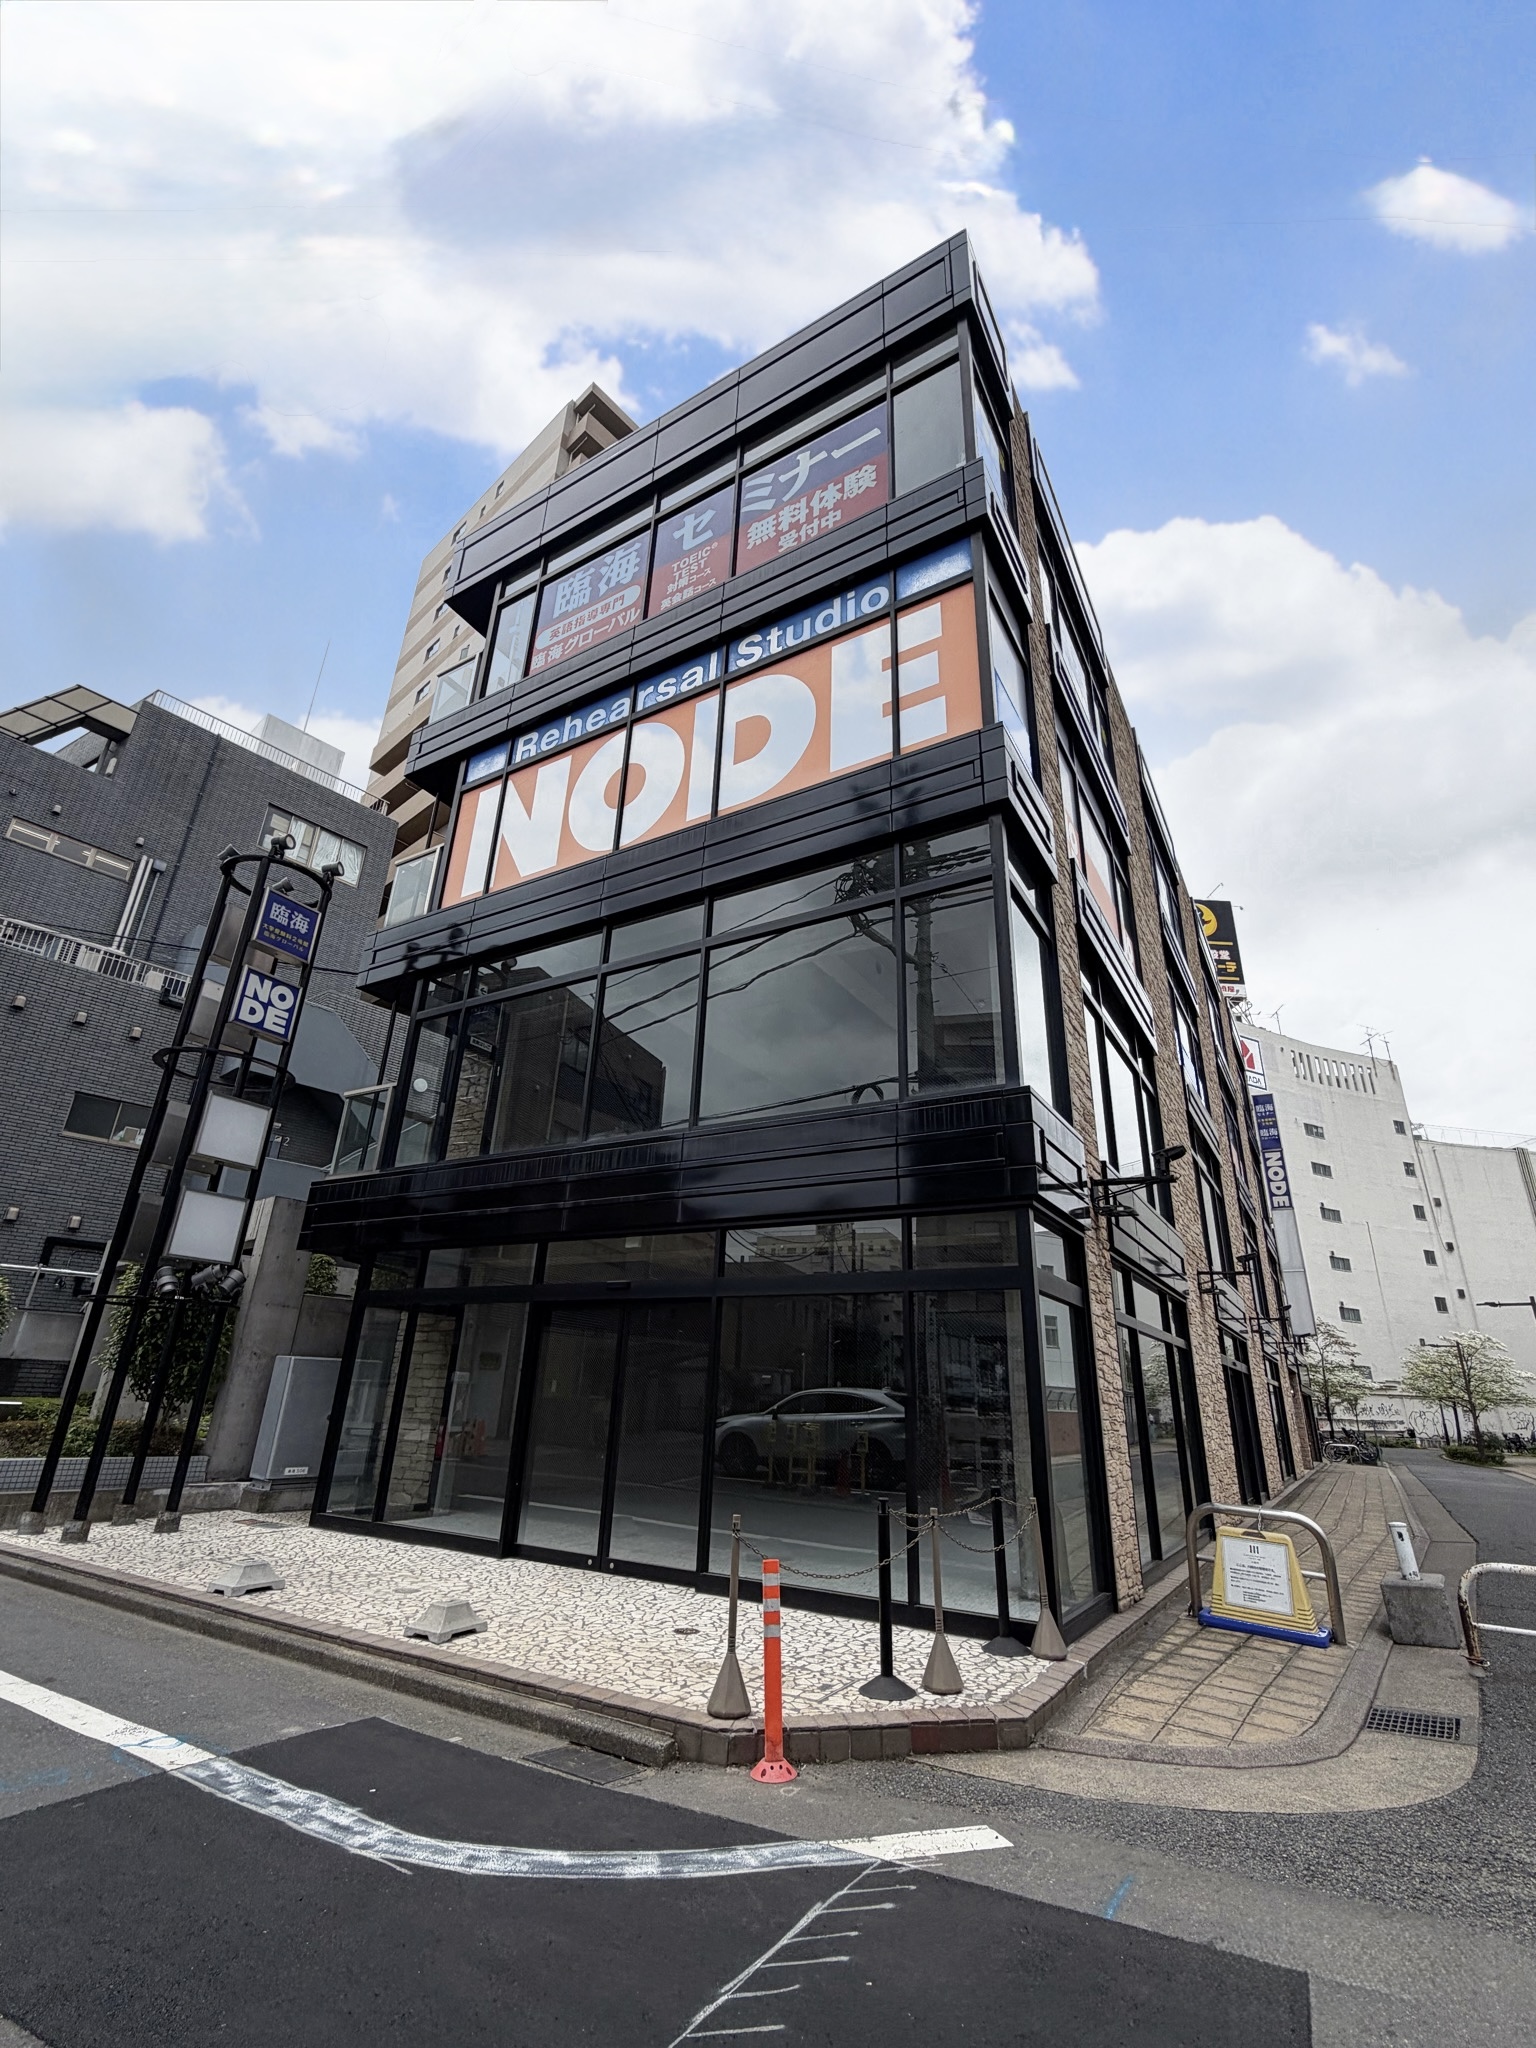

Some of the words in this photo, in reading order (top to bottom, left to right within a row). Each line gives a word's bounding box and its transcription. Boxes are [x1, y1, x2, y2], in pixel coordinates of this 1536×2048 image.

[747, 464, 877, 549] 無料体験
[778, 509, 842, 552] 受付中
[673, 557, 708, 582] TEST
[661, 578, 716, 610] 英会話コース
[532, 607, 641, 670] 臨海グローバル
[549, 595, 625, 641] 英語指導専門
[515, 652, 718, 763] Rehearsal
[736, 585, 890, 669] Studio
[461, 603, 948, 898] NODE
[269, 902, 310, 934] 臨海
[245, 973, 294, 1010] NO
[238, 996, 289, 1035] DE
[283, 1136, 290, 1146] 2
[1265, 1151, 1290, 1207] NODE
